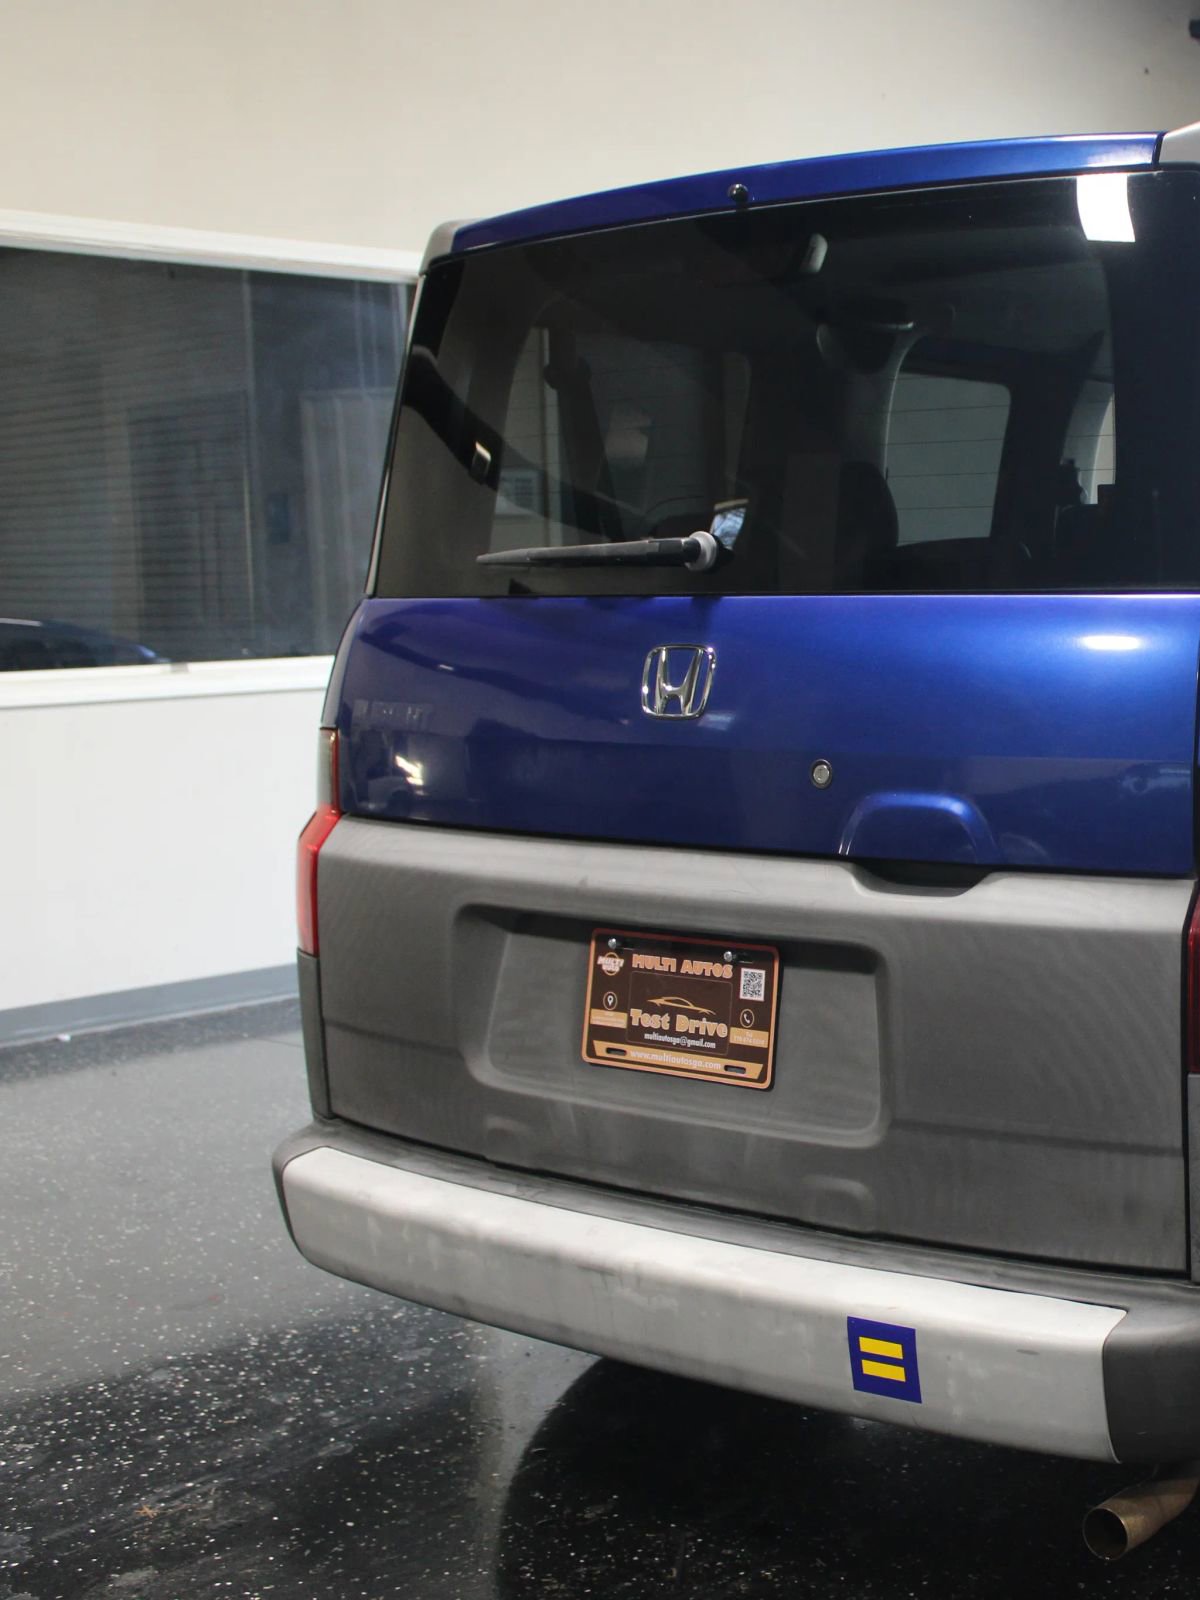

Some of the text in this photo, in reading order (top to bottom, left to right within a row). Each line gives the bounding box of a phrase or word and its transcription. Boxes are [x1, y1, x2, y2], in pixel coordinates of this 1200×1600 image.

[632, 954, 677, 973] MULTI
[680, 961, 733, 979] AUTOS
[630, 1008, 671, 1031] Test
[675, 1014, 728, 1038] Drive
[644, 1032, 717, 1049] multiautosga@gmail.com
[630, 1050, 722, 1071] www.multiautosga.com
